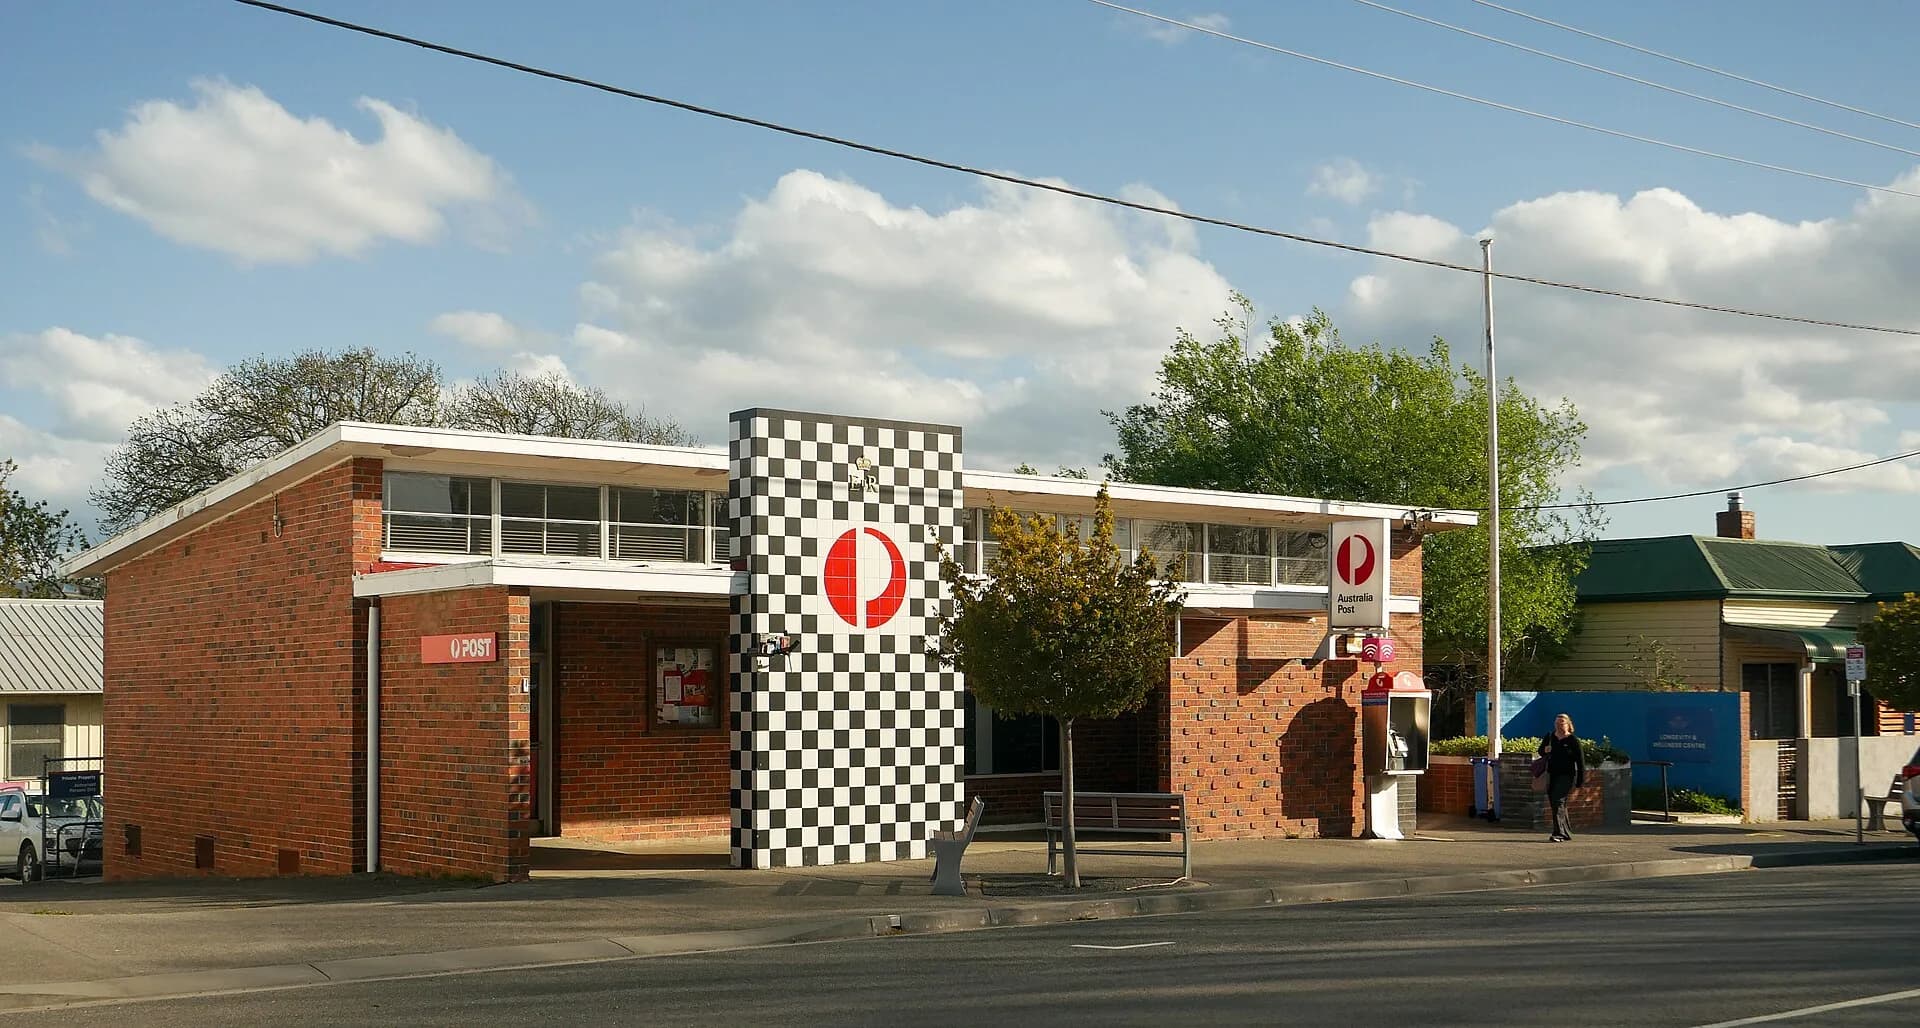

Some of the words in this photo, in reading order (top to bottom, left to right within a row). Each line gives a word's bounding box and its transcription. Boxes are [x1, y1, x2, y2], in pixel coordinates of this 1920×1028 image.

[1337, 593, 1373, 603] Australia
[1337, 604, 1355, 614] Post
[462, 638, 491, 657] POST
